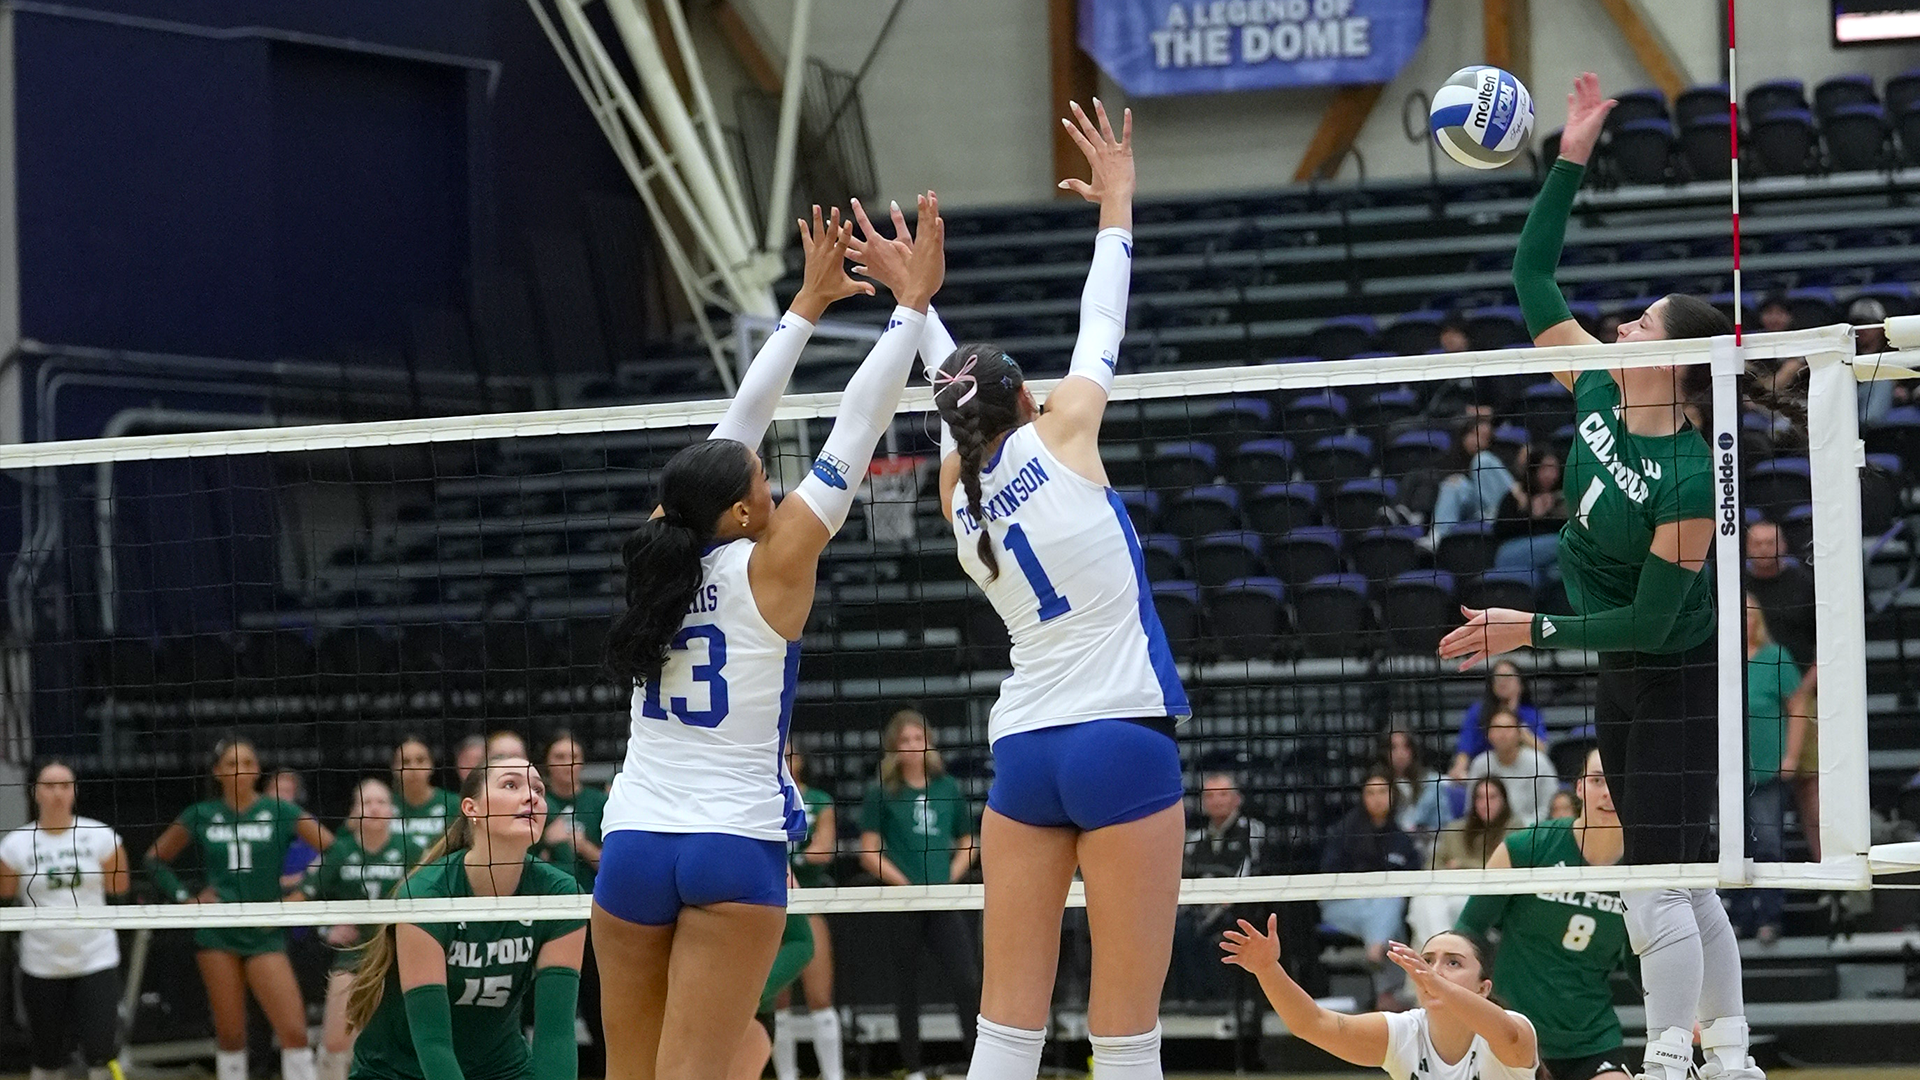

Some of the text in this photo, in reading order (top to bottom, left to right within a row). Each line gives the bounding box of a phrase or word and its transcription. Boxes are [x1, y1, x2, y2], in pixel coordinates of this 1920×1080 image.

[1168, 0, 1353, 28] A LEGEND OF
[1152, 17, 1371, 69] THE DOME
[1474, 75, 1497, 129] molten
[1491, 81, 1515, 132] NCAA
[1578, 411, 1616, 465] CAL
[1719, 453, 1736, 536] Schelde
[1003, 522, 1072, 622] 1
[642, 624, 730, 728] 13
[205, 823, 274, 843] CAL POLY
[227, 842, 253, 873] 11
[1581, 892, 1625, 915] POL
[1562, 913, 1597, 952] 8
[454, 974, 513, 1007] 15
